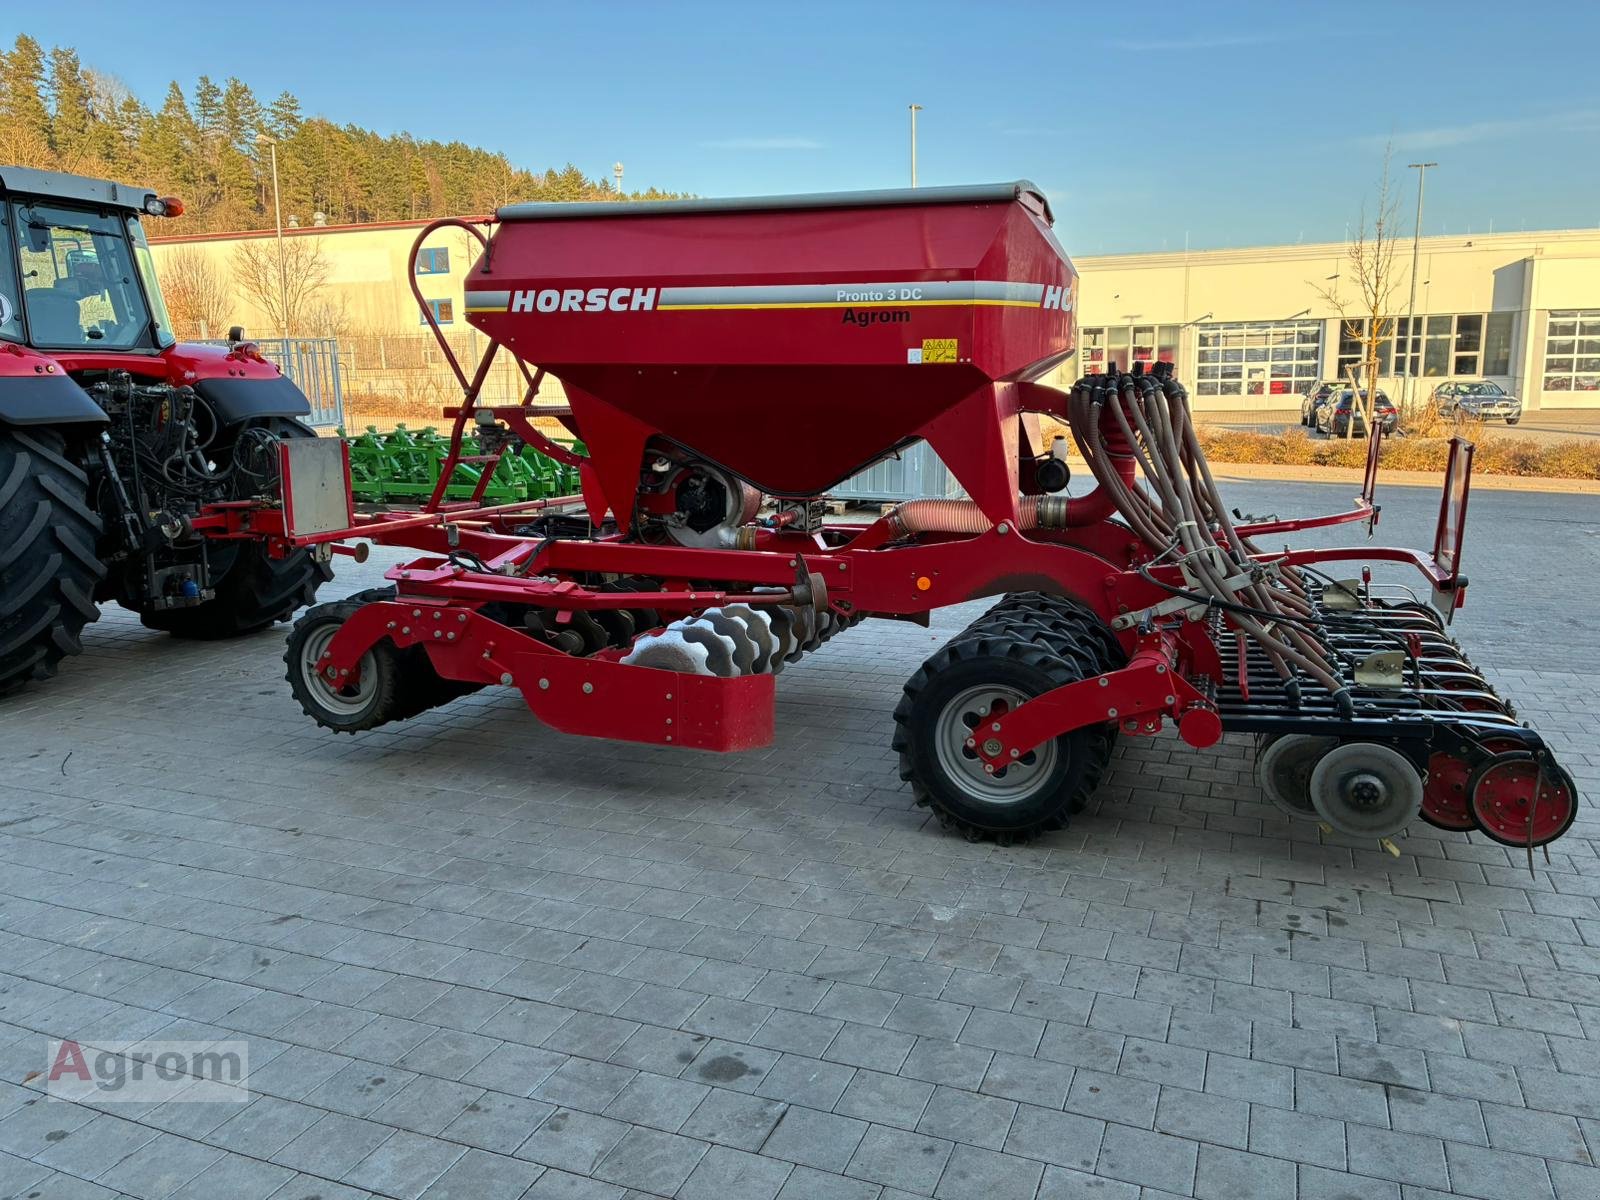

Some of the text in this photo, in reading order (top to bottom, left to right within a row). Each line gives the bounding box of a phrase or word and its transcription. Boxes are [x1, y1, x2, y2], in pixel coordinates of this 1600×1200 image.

[511, 287, 656, 312] HORSCH
[836, 288, 922, 301] Pronto 3 DC
[842, 307, 911, 327] Agrom
